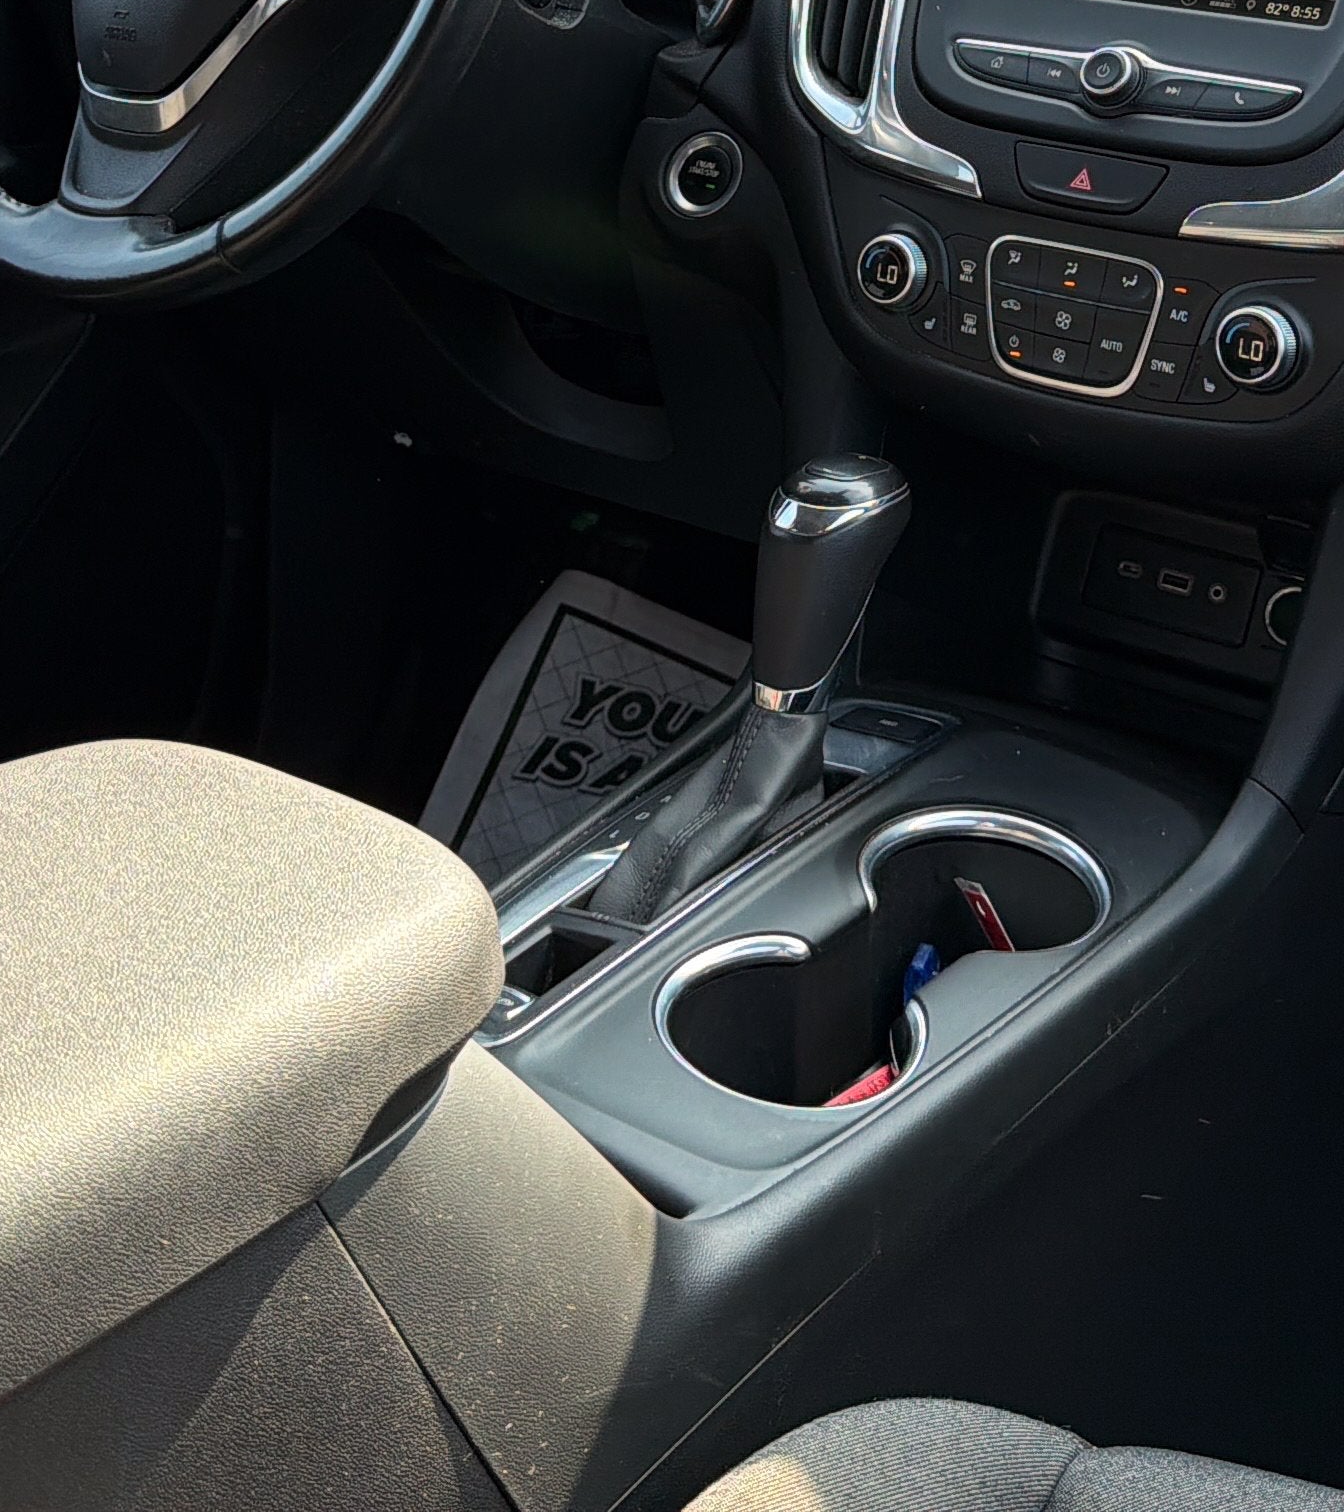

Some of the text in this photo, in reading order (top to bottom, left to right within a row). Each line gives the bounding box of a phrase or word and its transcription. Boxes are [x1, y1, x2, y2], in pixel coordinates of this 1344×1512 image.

[1290, 5, 1321, 20] 8:55
[877, 263, 898, 285] LO
[1169, 308, 1189, 323] A/C
[1100, 339, 1123, 353] AUTO
[1238, 337, 1264, 362] LO
[1150, 359, 1176, 375] SYNC
[520, 735, 598, 782] IS
